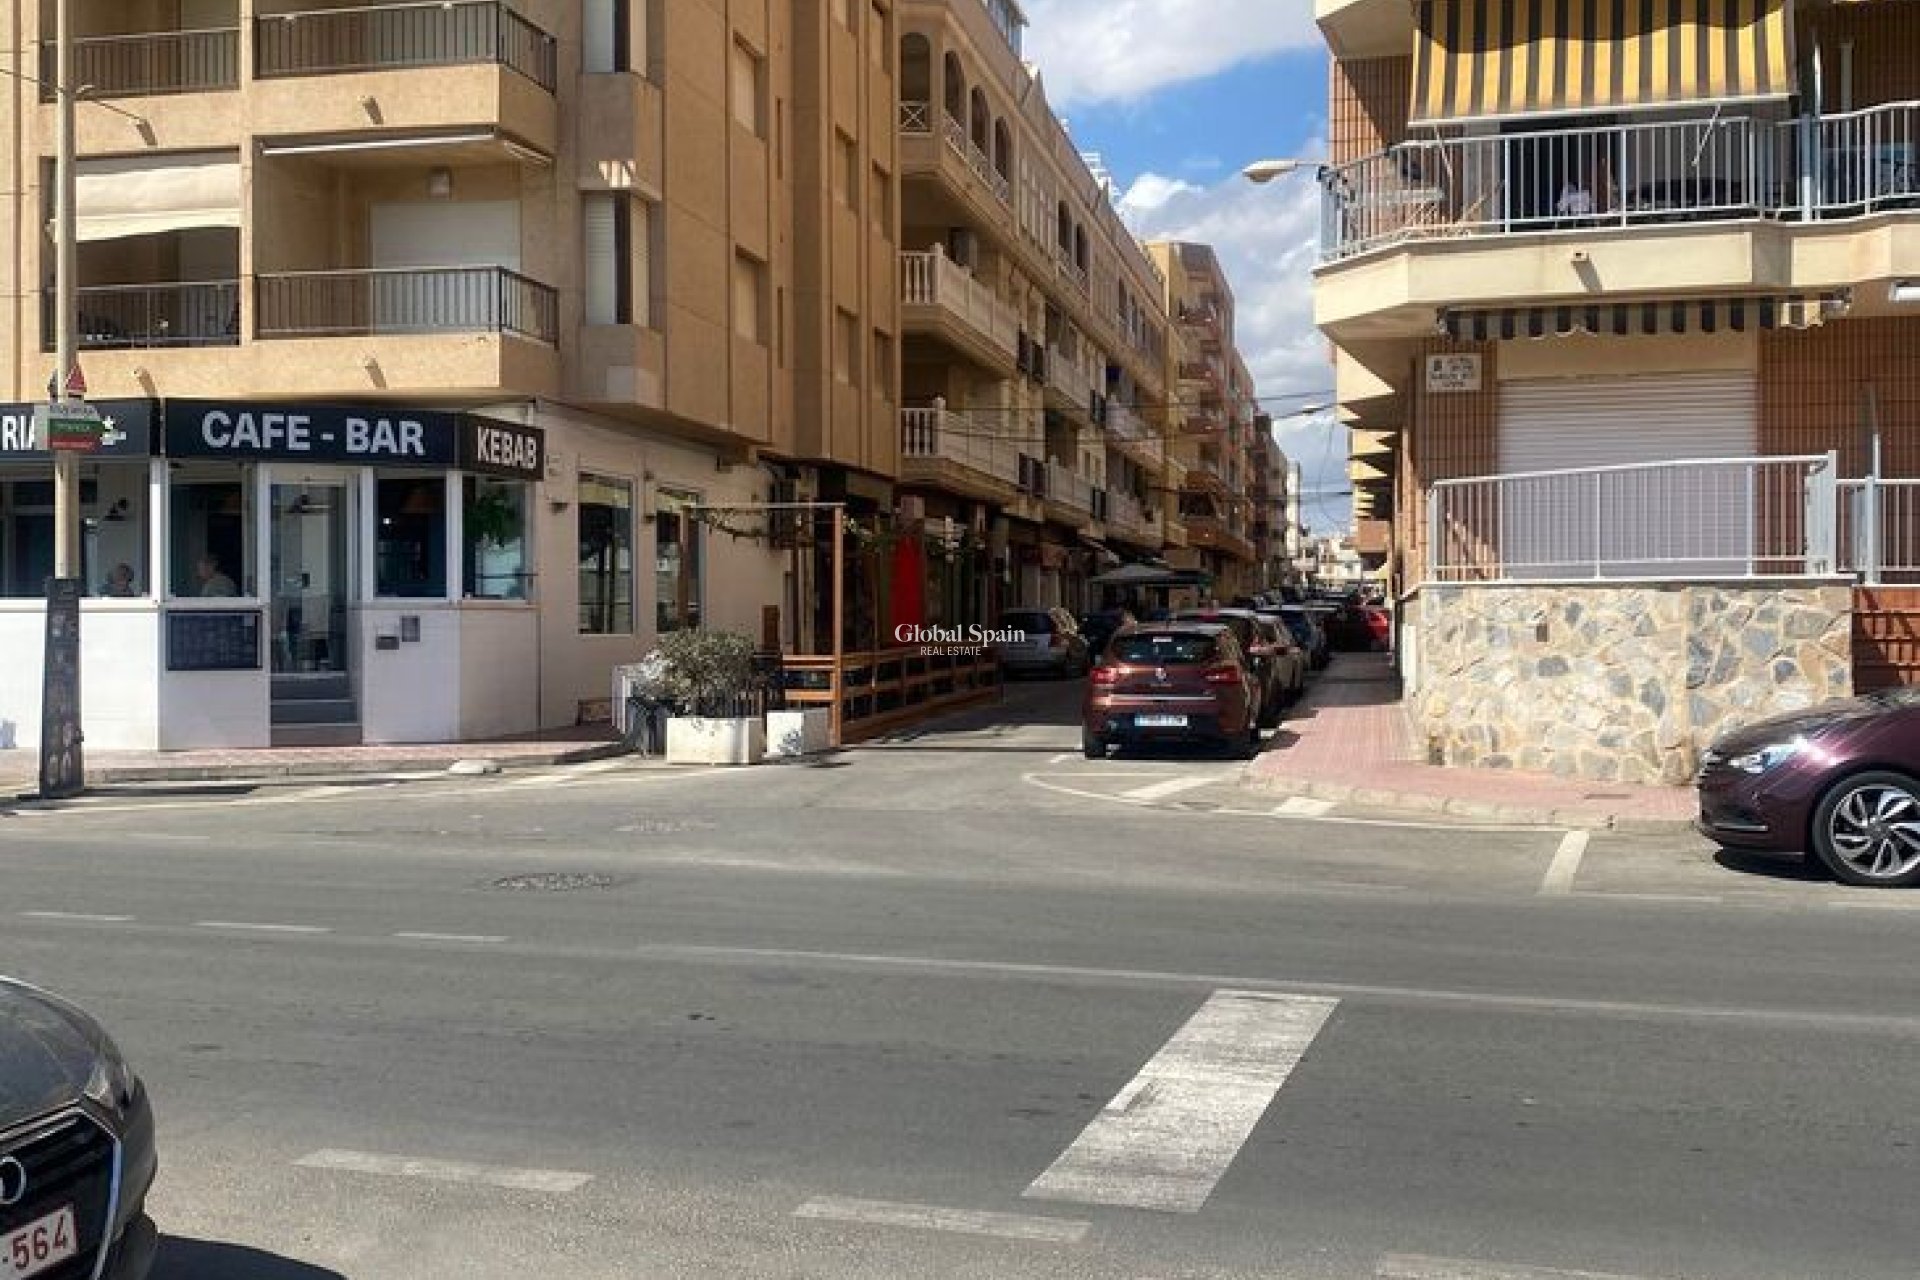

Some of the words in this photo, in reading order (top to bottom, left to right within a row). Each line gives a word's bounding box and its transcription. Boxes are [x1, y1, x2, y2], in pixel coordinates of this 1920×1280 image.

[201, 410, 311, 450] CAFE
[346, 417, 425, 456] BAR
[477, 425, 537, 469] KEBAB
